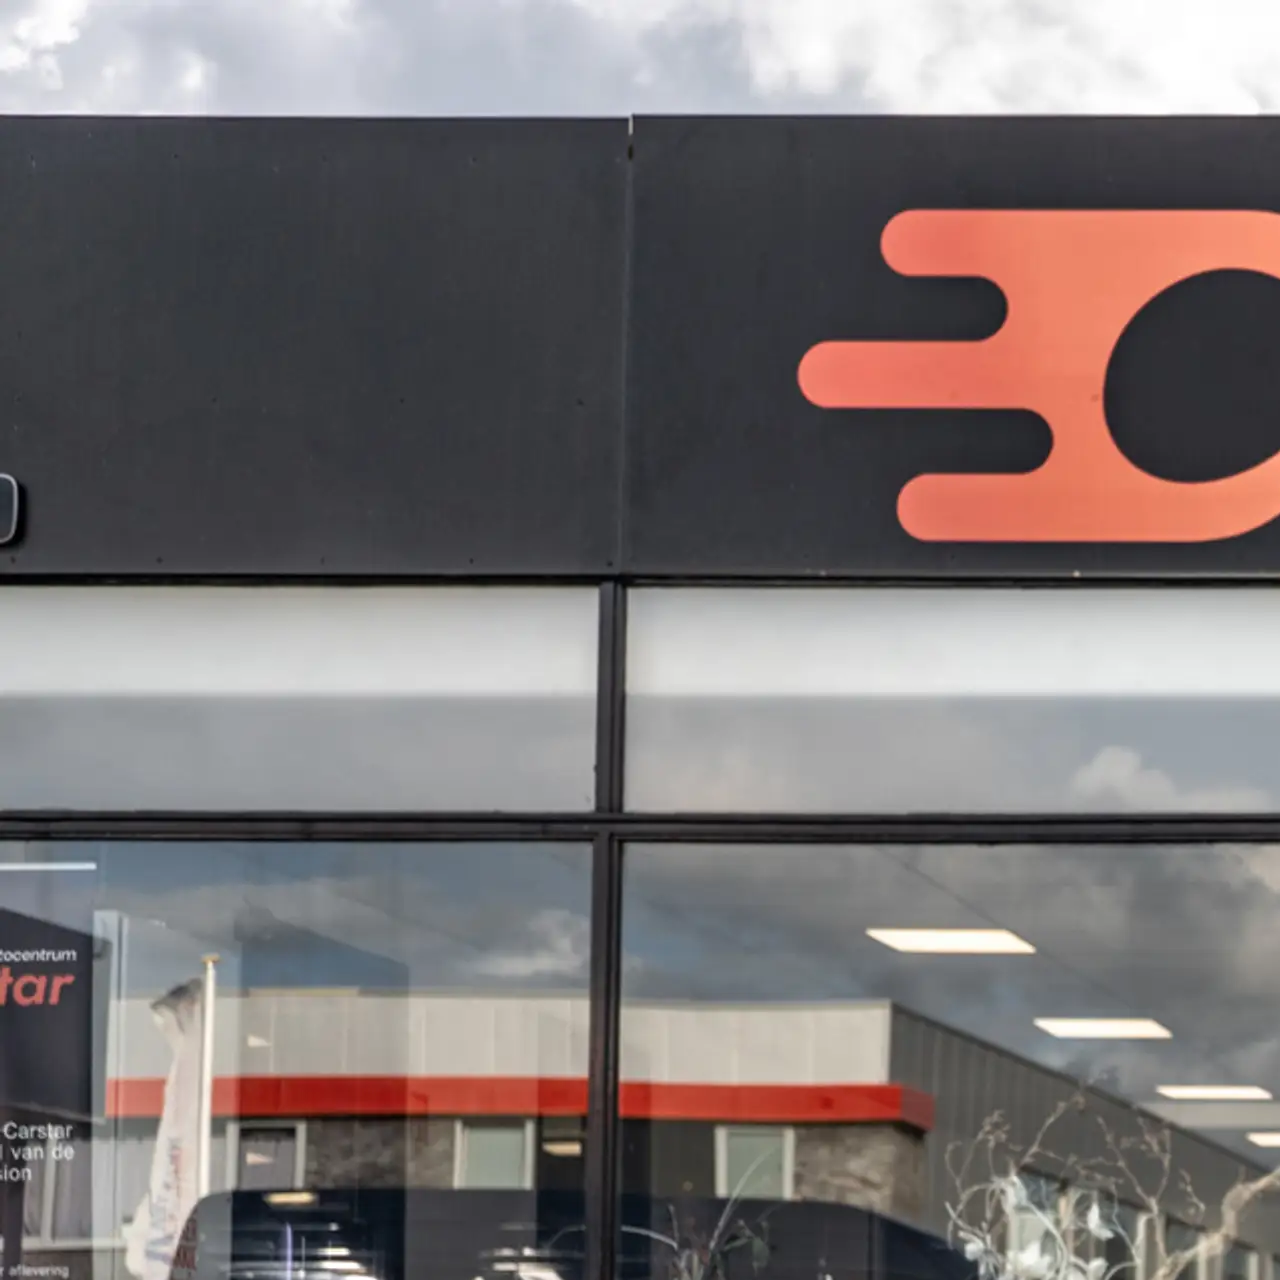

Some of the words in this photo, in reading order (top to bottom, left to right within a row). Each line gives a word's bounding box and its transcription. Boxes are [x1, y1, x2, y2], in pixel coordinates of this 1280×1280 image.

[3, 1121, 73, 1140] Carstar
[10, 1145, 45, 1161] van
[51, 1142, 75, 1161] de
